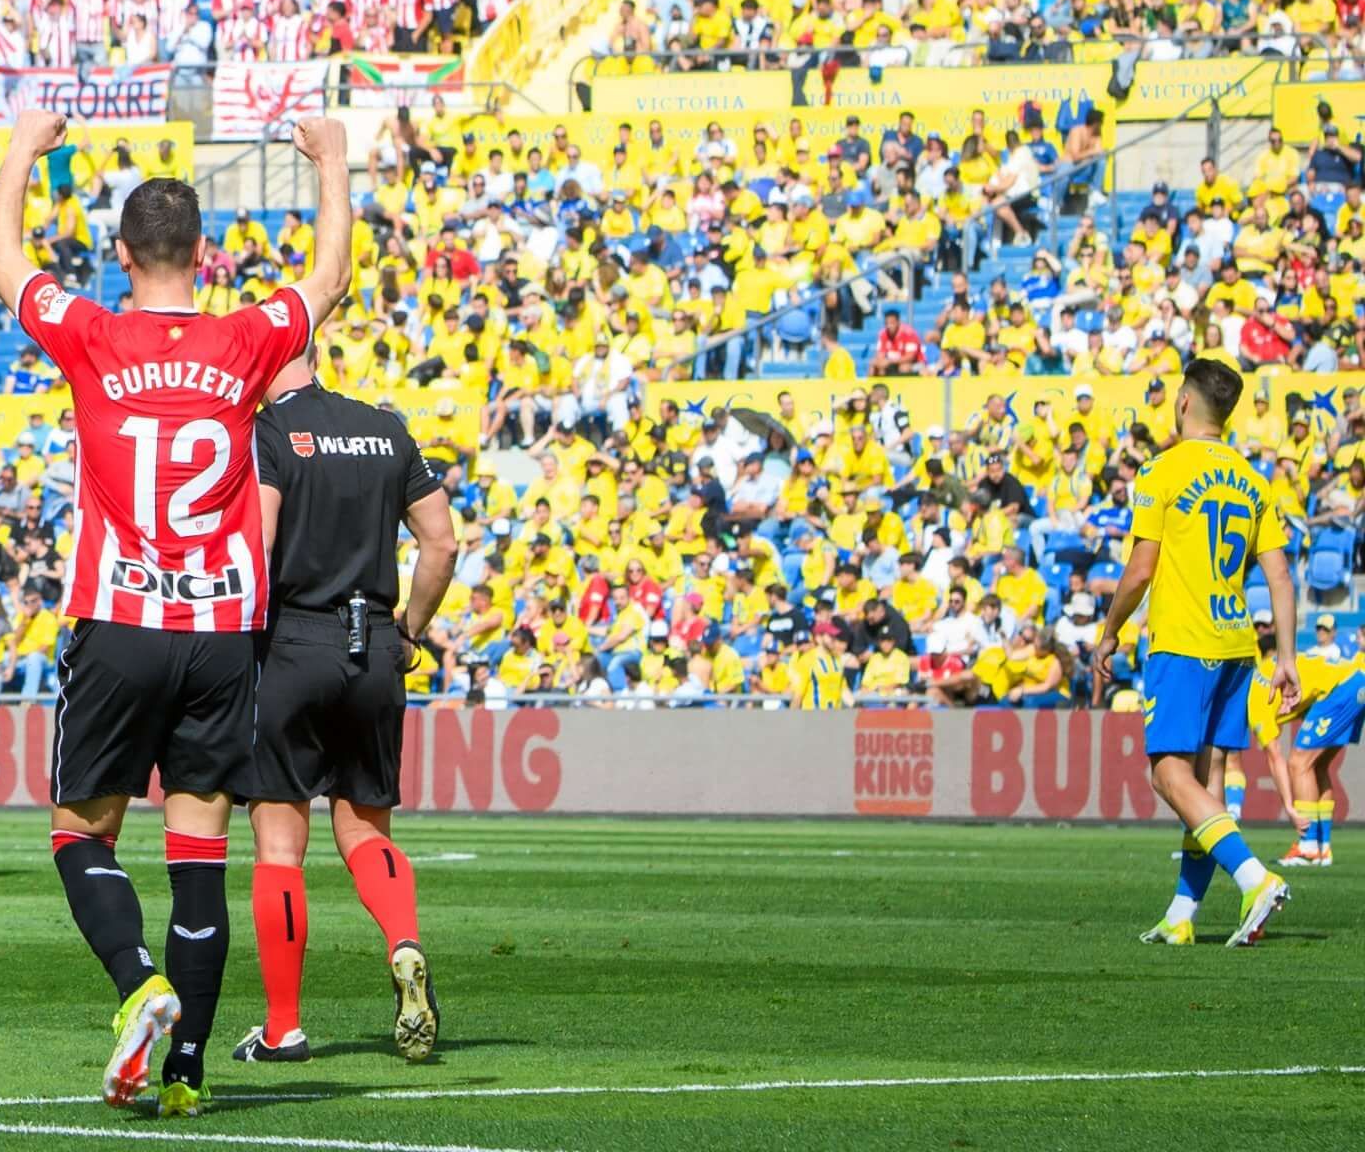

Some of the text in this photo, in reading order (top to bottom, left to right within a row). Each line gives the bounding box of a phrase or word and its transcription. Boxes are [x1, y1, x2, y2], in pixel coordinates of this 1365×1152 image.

[636, 95, 747, 111] VICTORIA
[101, 363, 246, 408] GURUZETA
[118, 415, 233, 541] 12
[1198, 499, 1252, 581] 15
[109, 559, 244, 602] DIGI
[400, 706, 563, 811] ING
[854, 730, 934, 757] BURGER
[854, 759, 934, 797] KING
